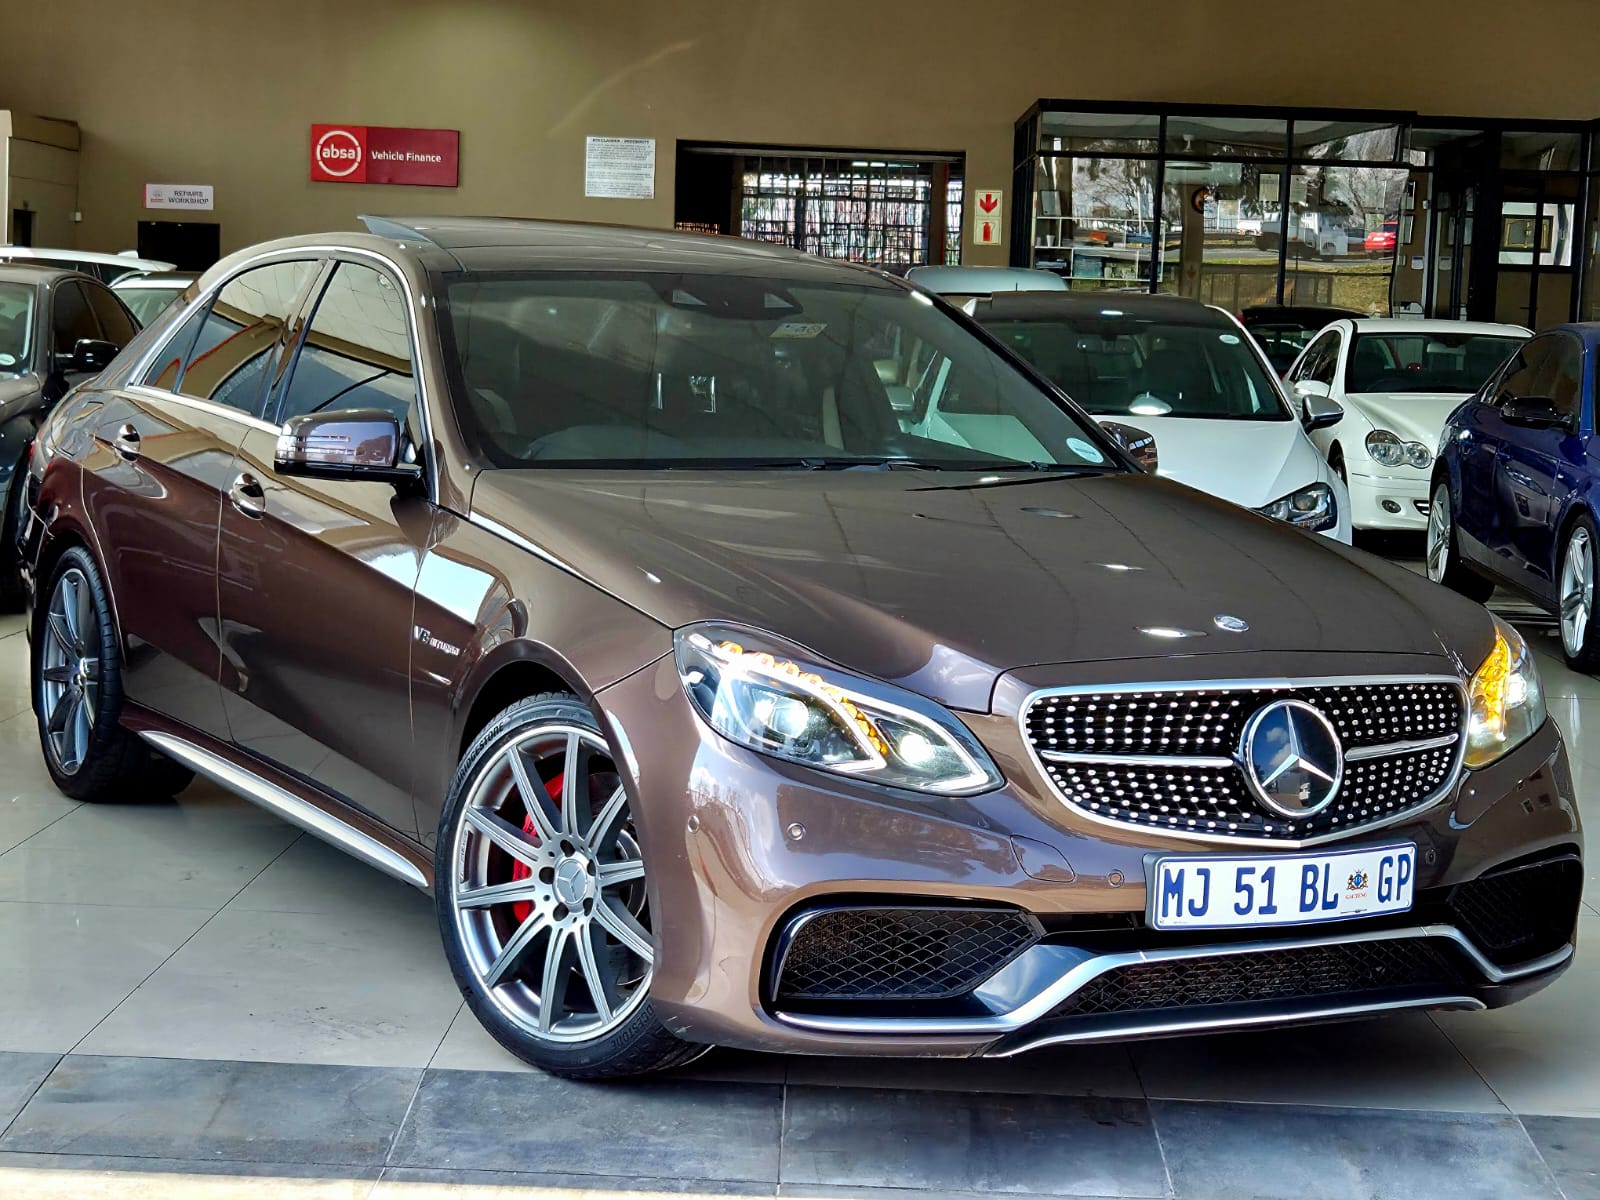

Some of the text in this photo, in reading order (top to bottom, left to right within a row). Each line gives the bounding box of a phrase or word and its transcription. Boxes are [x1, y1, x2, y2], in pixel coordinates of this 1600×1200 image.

[322, 143, 356, 159] absa
[371, 150, 442, 163] Vehicle Finance
[1161, 853, 1412, 918] MJ 51 BL GP
[610, 1003, 656, 1050] DGESTONE
